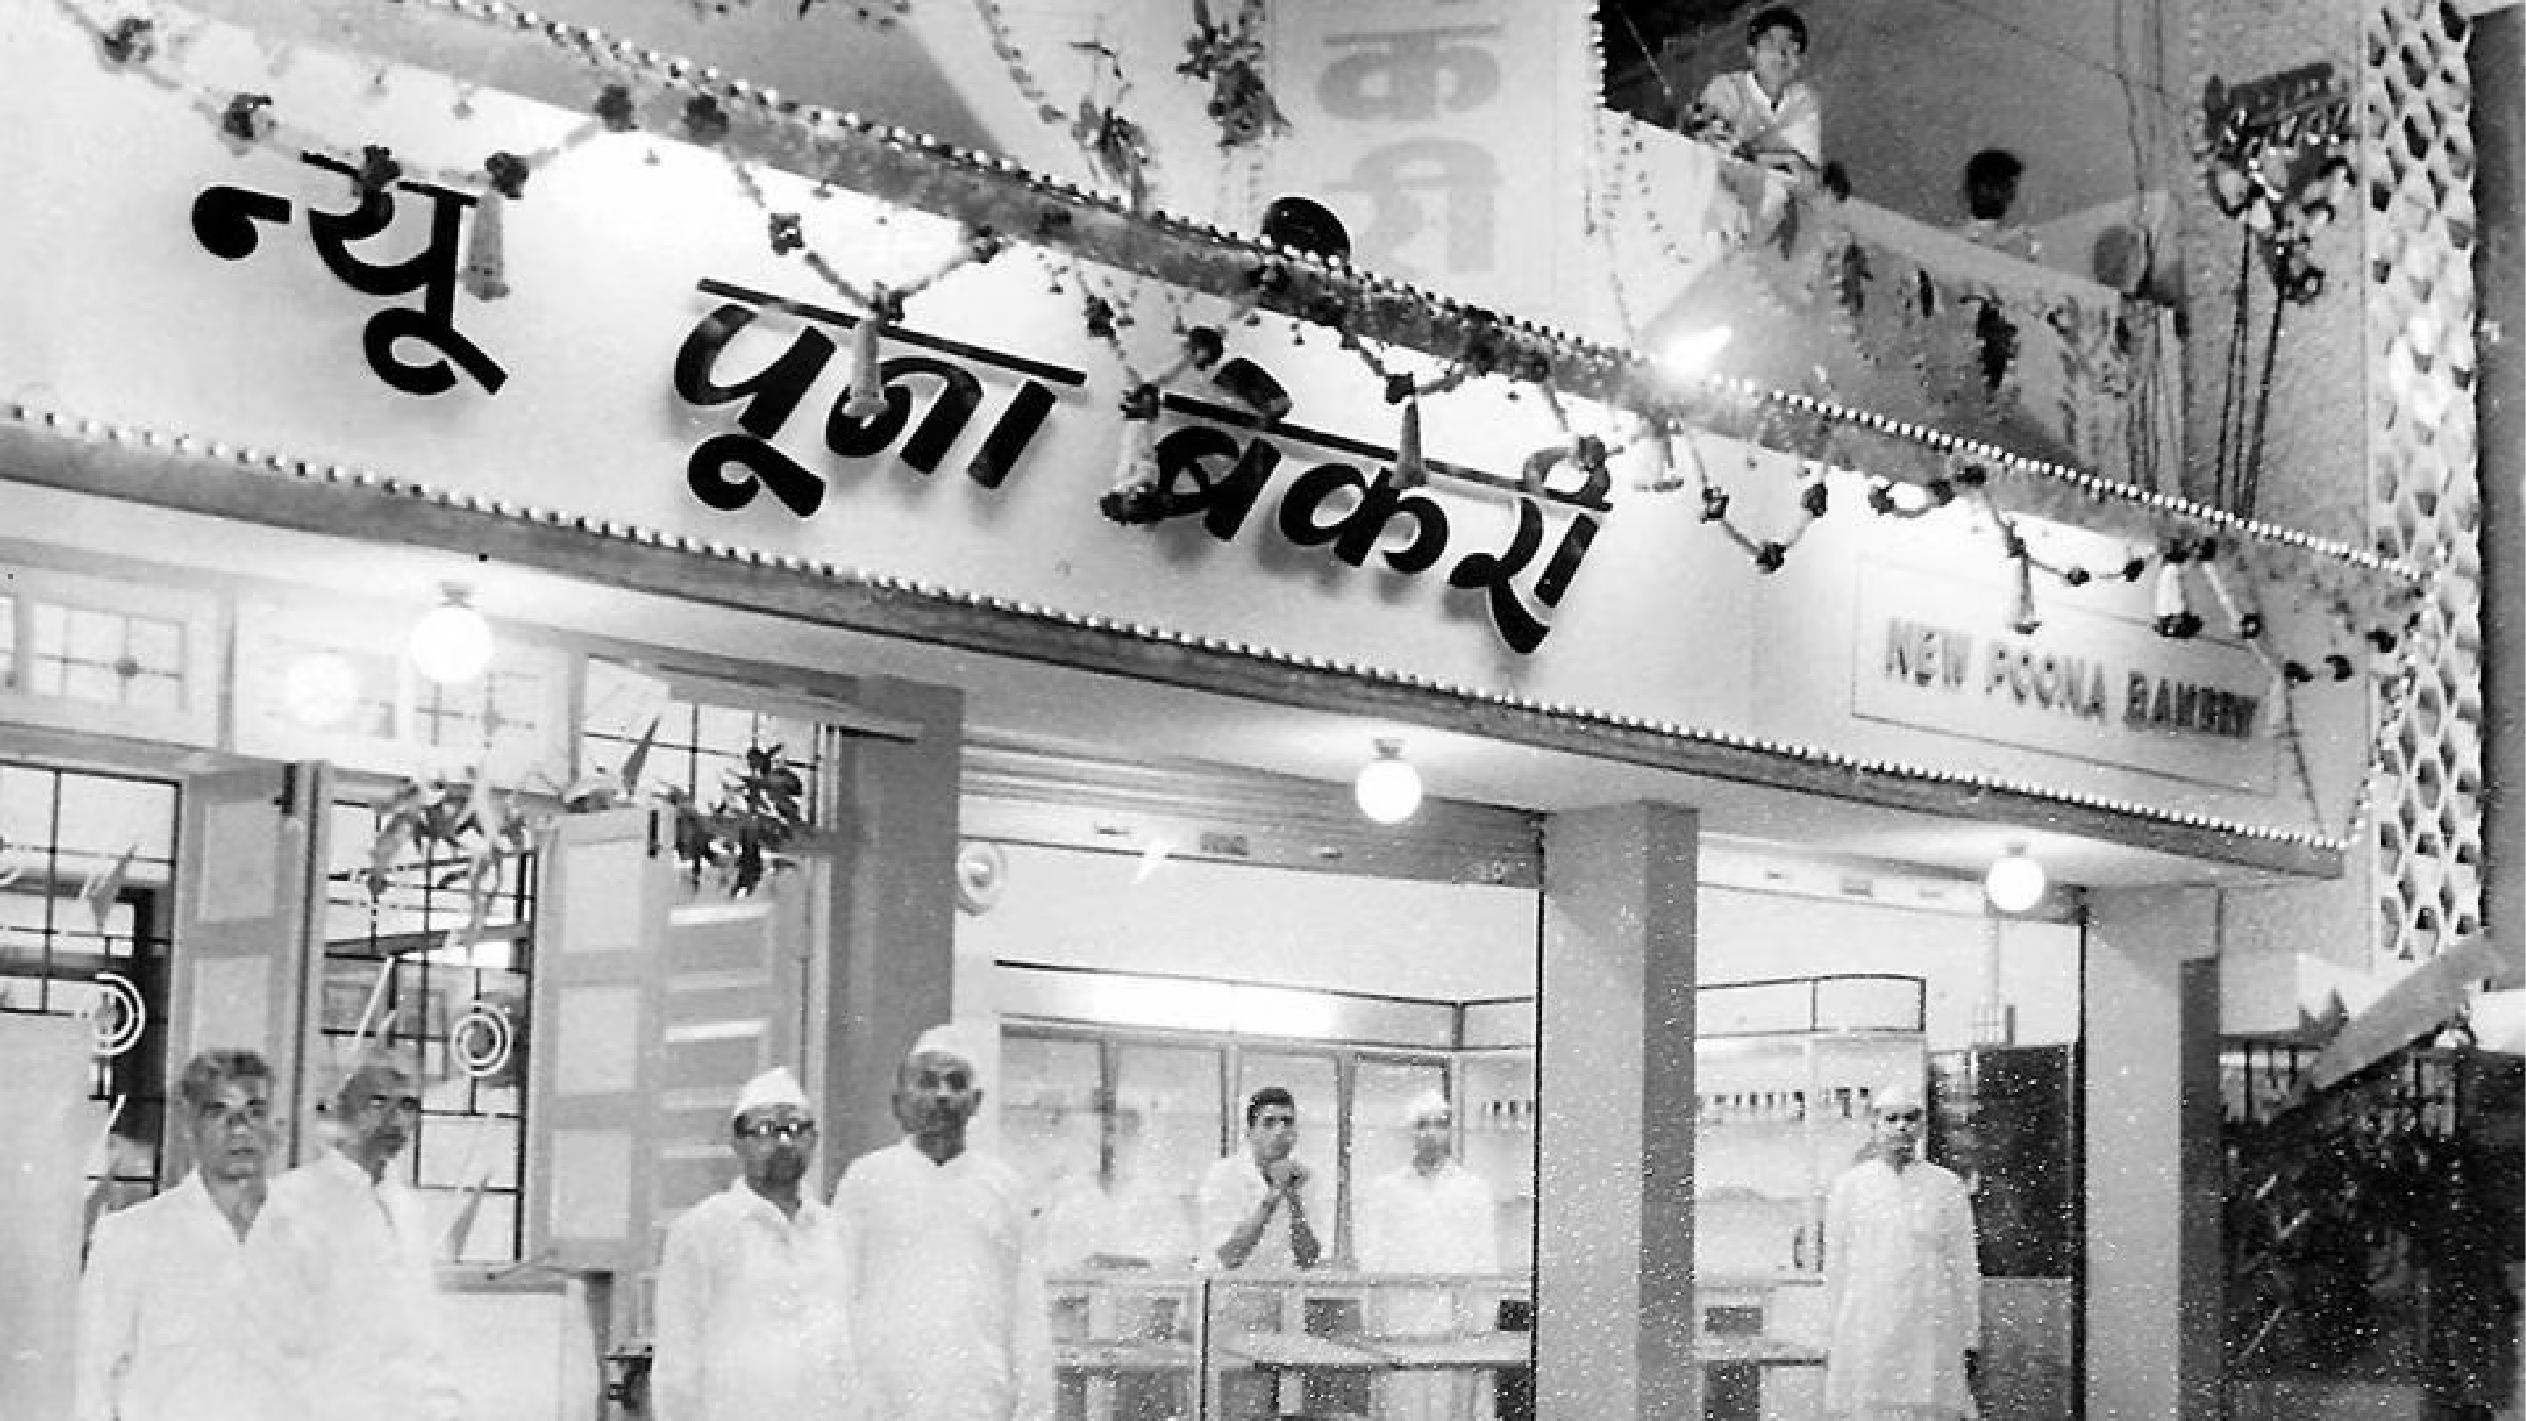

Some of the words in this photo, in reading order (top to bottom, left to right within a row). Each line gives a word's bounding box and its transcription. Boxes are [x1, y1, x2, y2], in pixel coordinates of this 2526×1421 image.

[1317, 0, 1502, 284] करी
[191, 149, 509, 395] न्यू
[673, 277, 1087, 518] पूना
[1108, 356, 1614, 654] बेकरी
[1886, 617, 1972, 687] NEW
[1985, 640, 2107, 725] POONA
[2124, 669, 2260, 740] BAKERY
